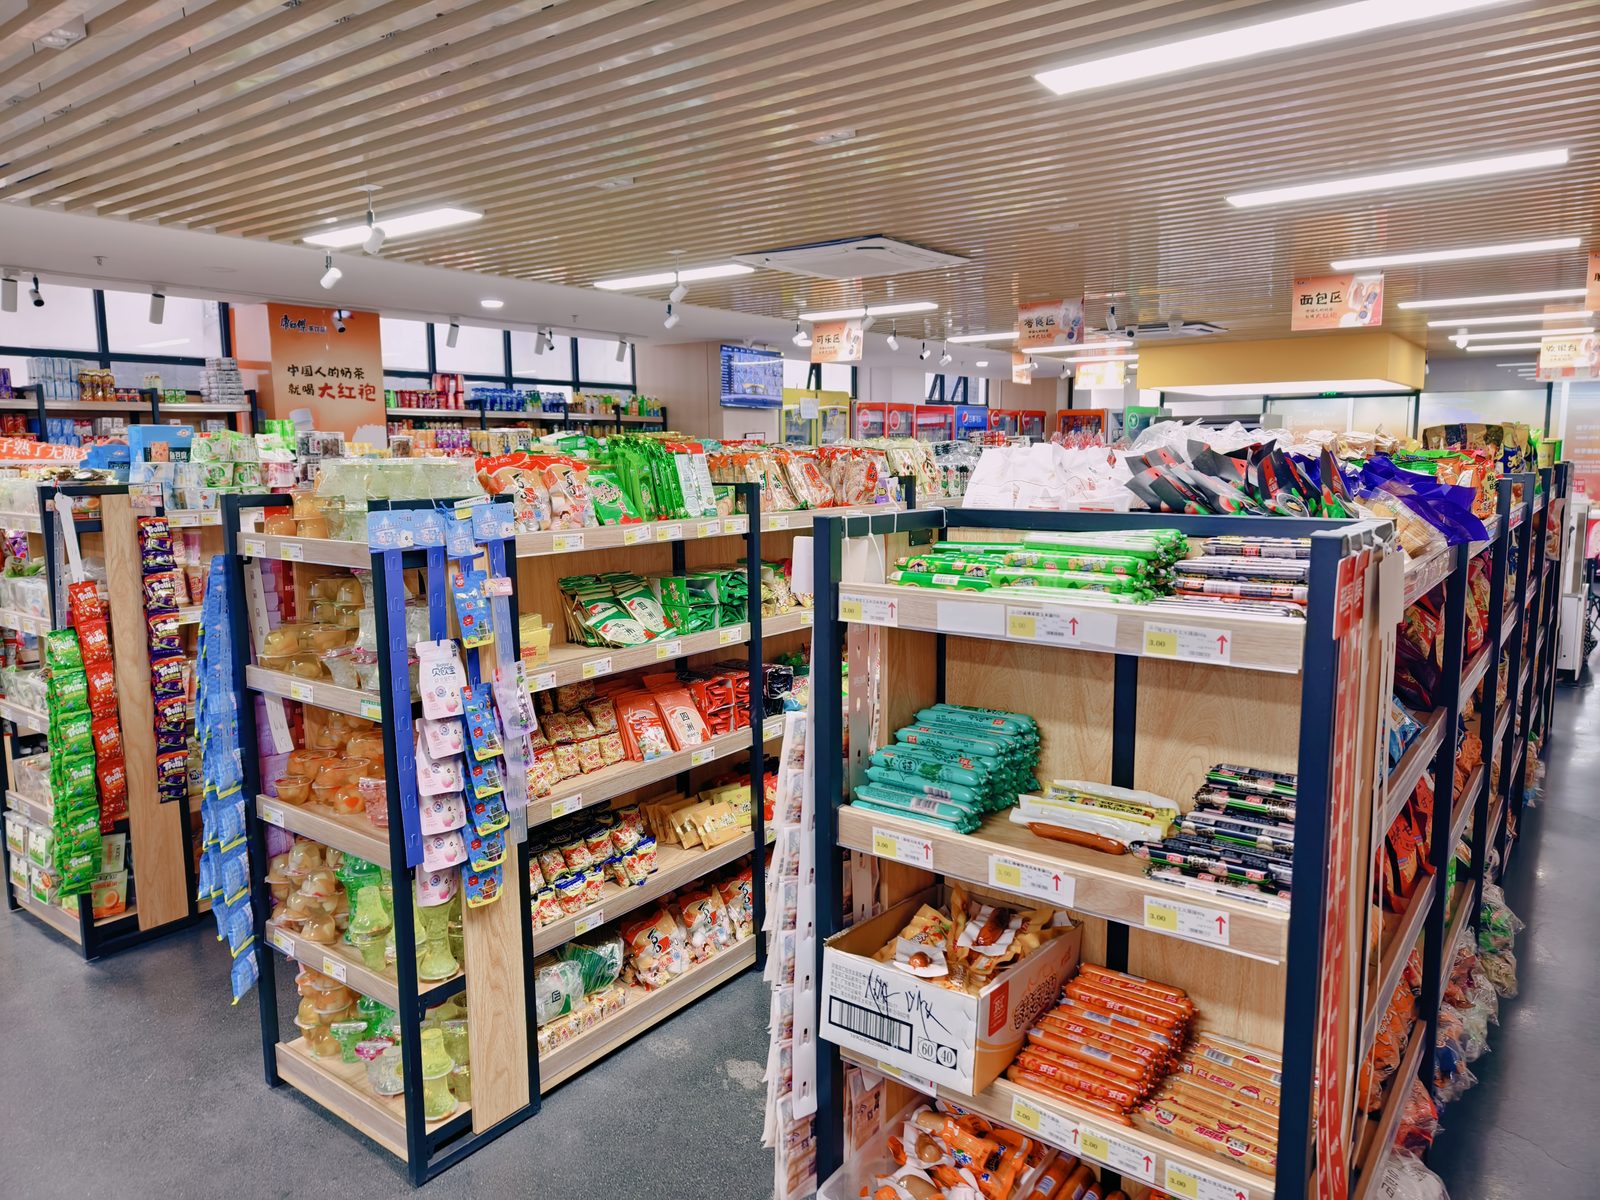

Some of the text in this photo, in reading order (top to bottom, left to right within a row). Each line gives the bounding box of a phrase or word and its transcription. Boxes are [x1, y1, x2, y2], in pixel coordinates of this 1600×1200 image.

[1299, 290, 1343, 306] 面包区
[816, 333, 840, 344] 可乐区
[287, 363, 365, 380] 中国人的奶茶
[288, 382, 377, 402] 就喝大红袍
[1149, 639, 1166, 648] 3.00
[160, 665, 179, 676] Trolli
[66, 726, 88, 738] Trolli
[163, 759, 184, 771] Trolli
[72, 768, 91, 781] Trolli
[104, 772, 124, 785] Trolli
[77, 820, 97, 833] Trolli
[69, 854, 92, 868] Trolli
[1150, 913, 1167, 922] 3.00
[921, 1043, 934, 1057] 60
[940, 1050, 953, 1064] 40
[1016, 1110, 1031, 1121] 2.00
[1082, 1139, 1098, 1150] 2.00
[1169, 1177, 1187, 1188] 3.00
